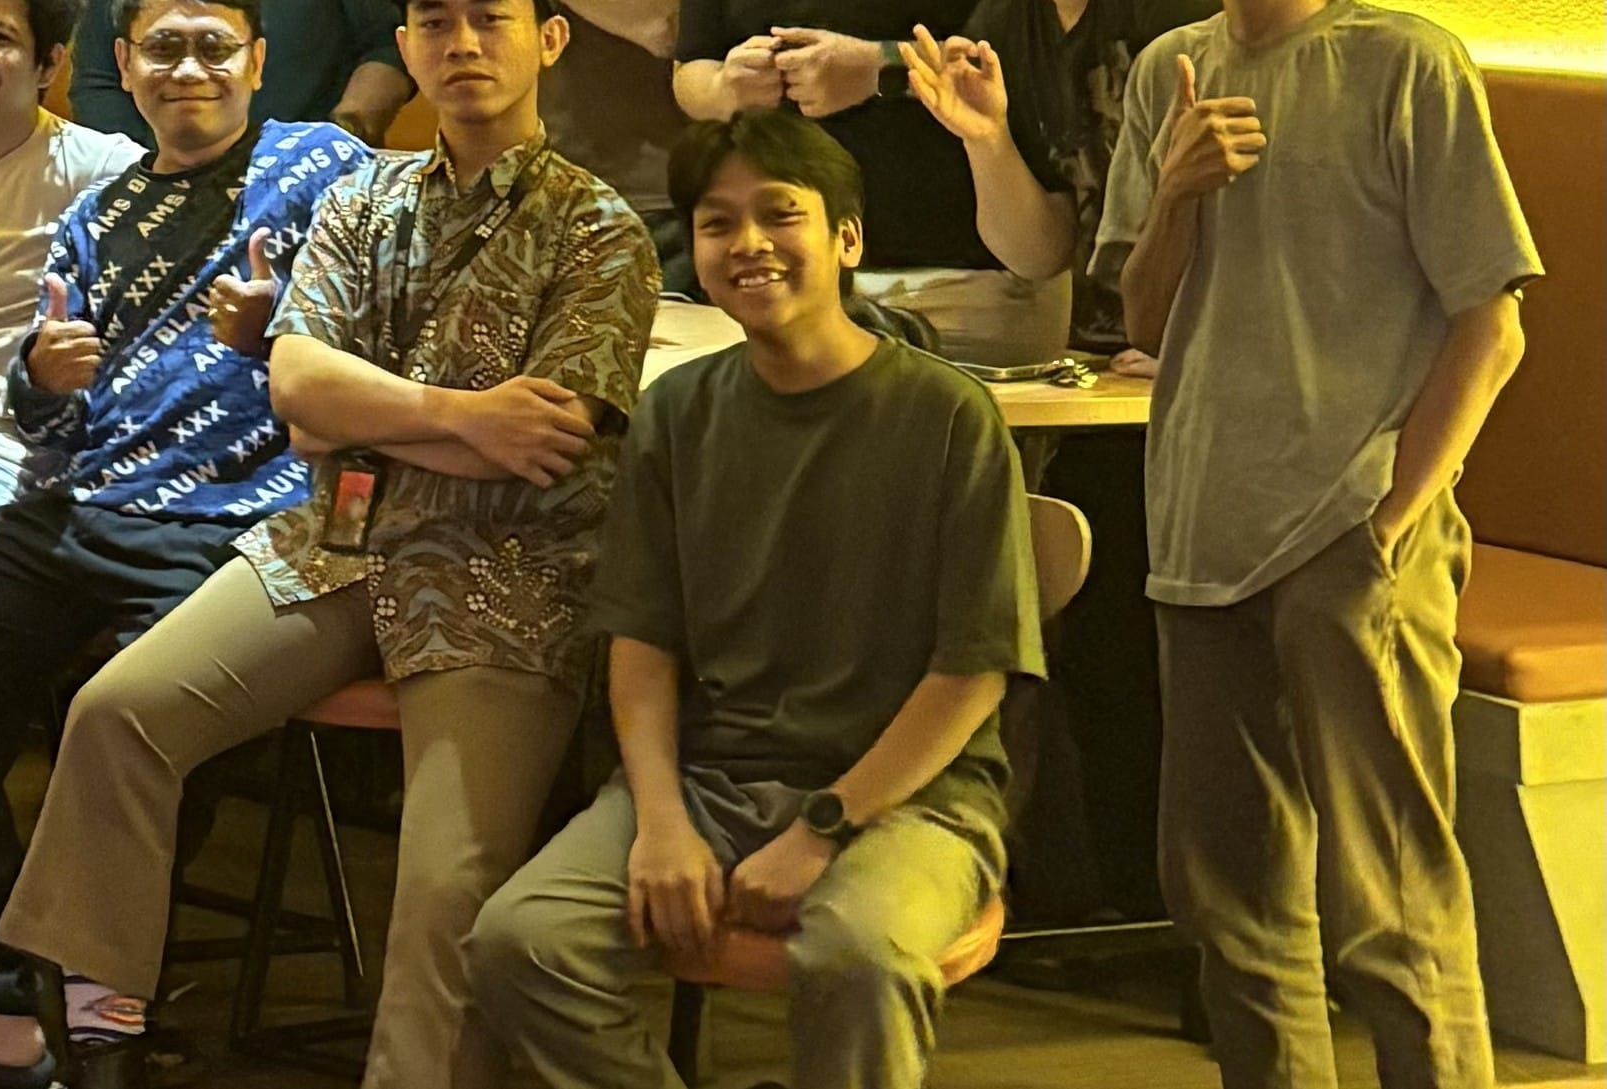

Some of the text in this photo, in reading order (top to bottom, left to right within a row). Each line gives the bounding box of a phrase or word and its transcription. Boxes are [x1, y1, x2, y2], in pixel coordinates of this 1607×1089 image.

[278, 147, 332, 194] AMS
[87, 198, 132, 241] AMS
[137, 194, 187, 239] AMS
[123, 253, 176, 307] XXX
[112, 345, 160, 395] AMS
[168, 400, 230, 444] XXX
[227, 419, 281, 463] XXX
